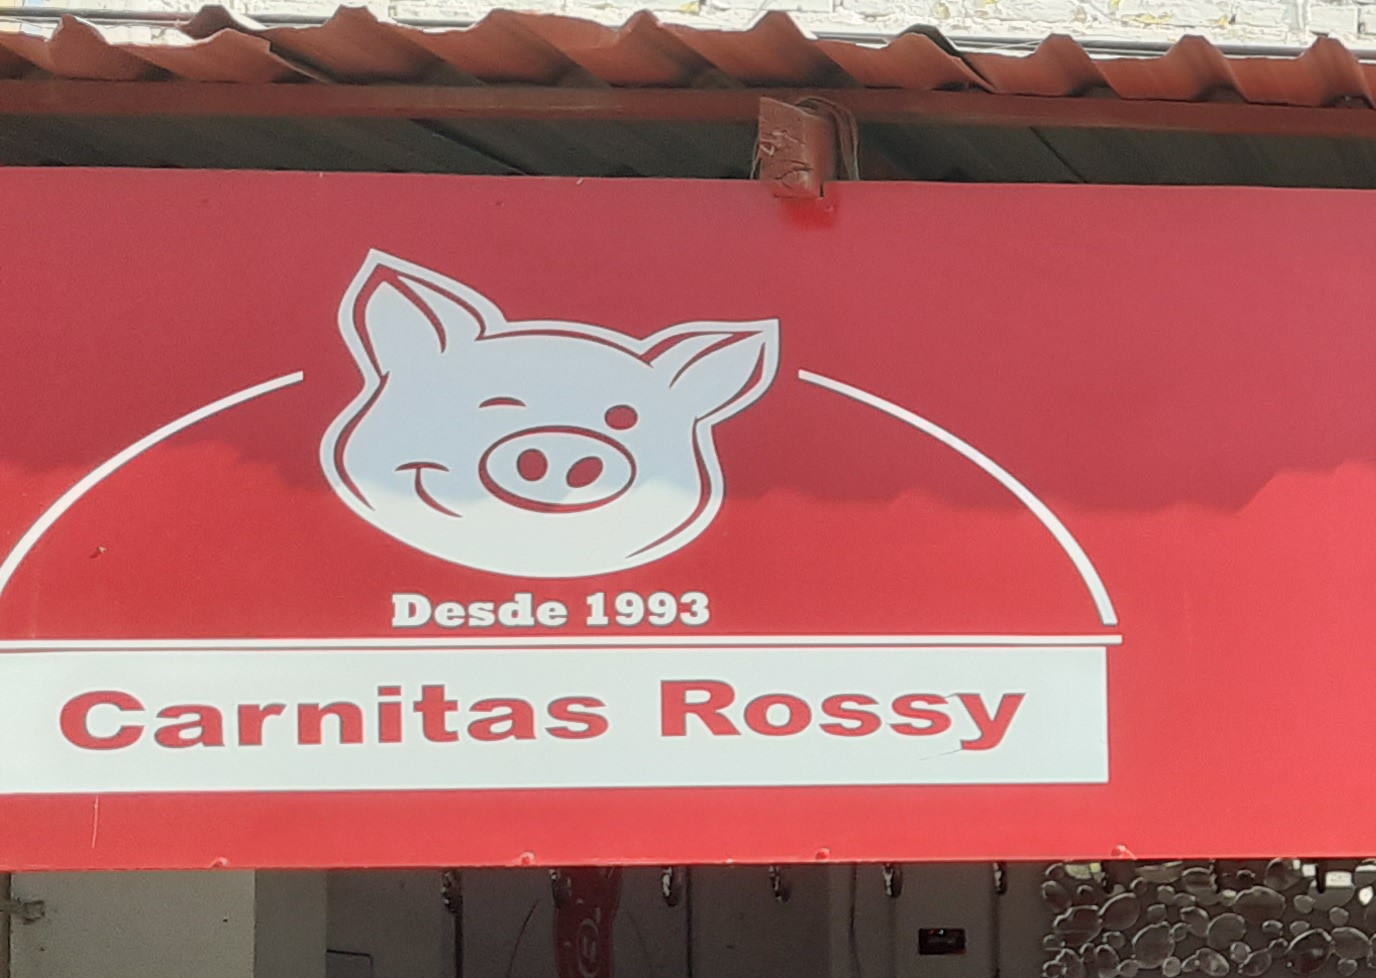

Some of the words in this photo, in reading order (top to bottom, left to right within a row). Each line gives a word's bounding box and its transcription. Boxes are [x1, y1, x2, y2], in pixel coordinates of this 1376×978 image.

[391, 592, 568, 628] Desde
[586, 591, 711, 627] 1993
[59, 685, 610, 750] Carnitas
[660, 679, 1026, 752] Rossy
